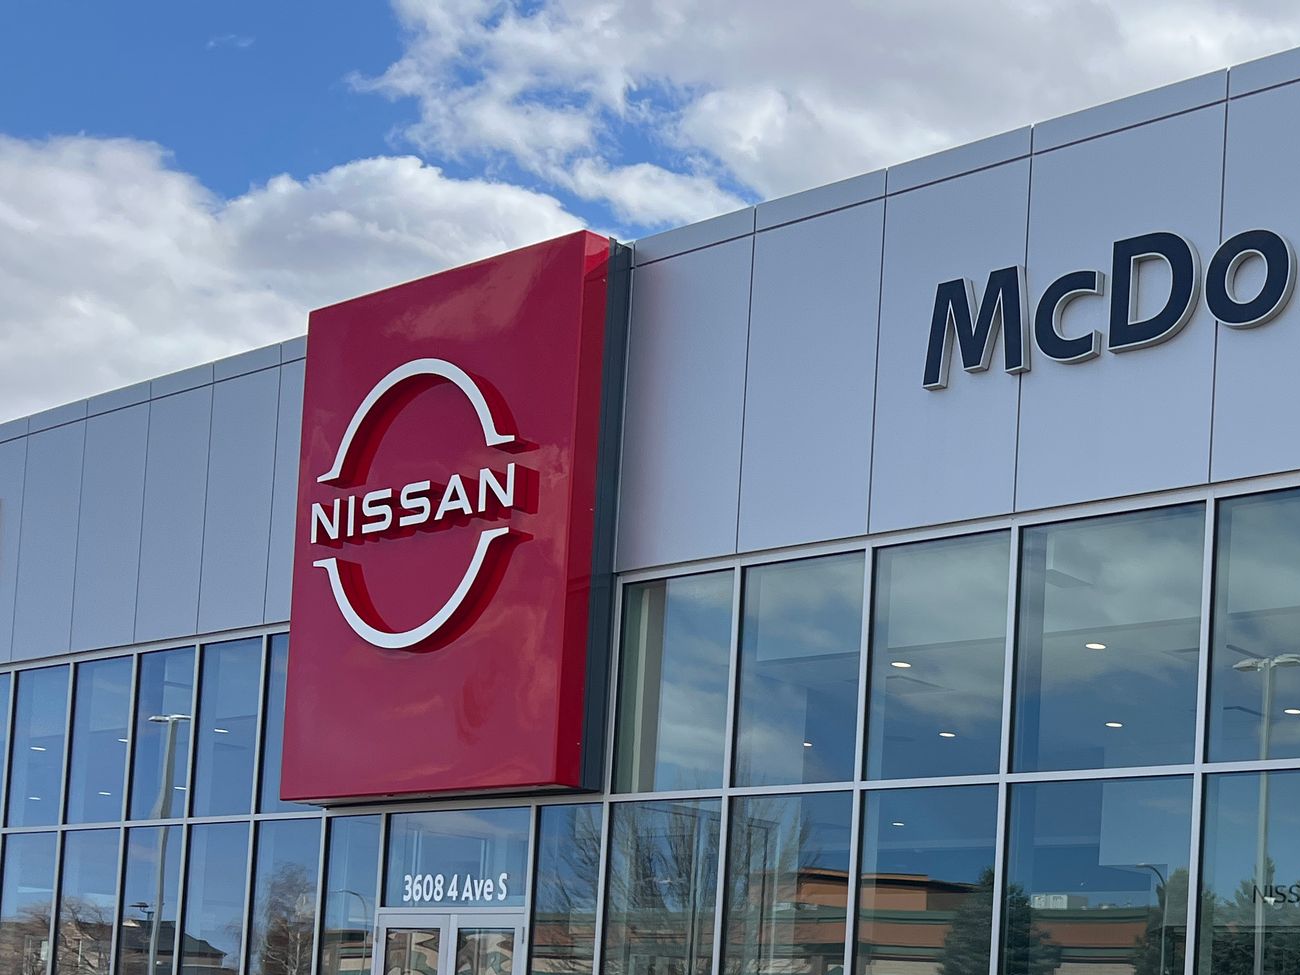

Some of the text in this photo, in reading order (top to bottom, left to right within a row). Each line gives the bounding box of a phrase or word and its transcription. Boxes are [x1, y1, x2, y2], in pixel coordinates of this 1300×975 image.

[310, 462, 516, 544] NISSAN
[402, 872, 509, 902] 3608 4 Ave S
